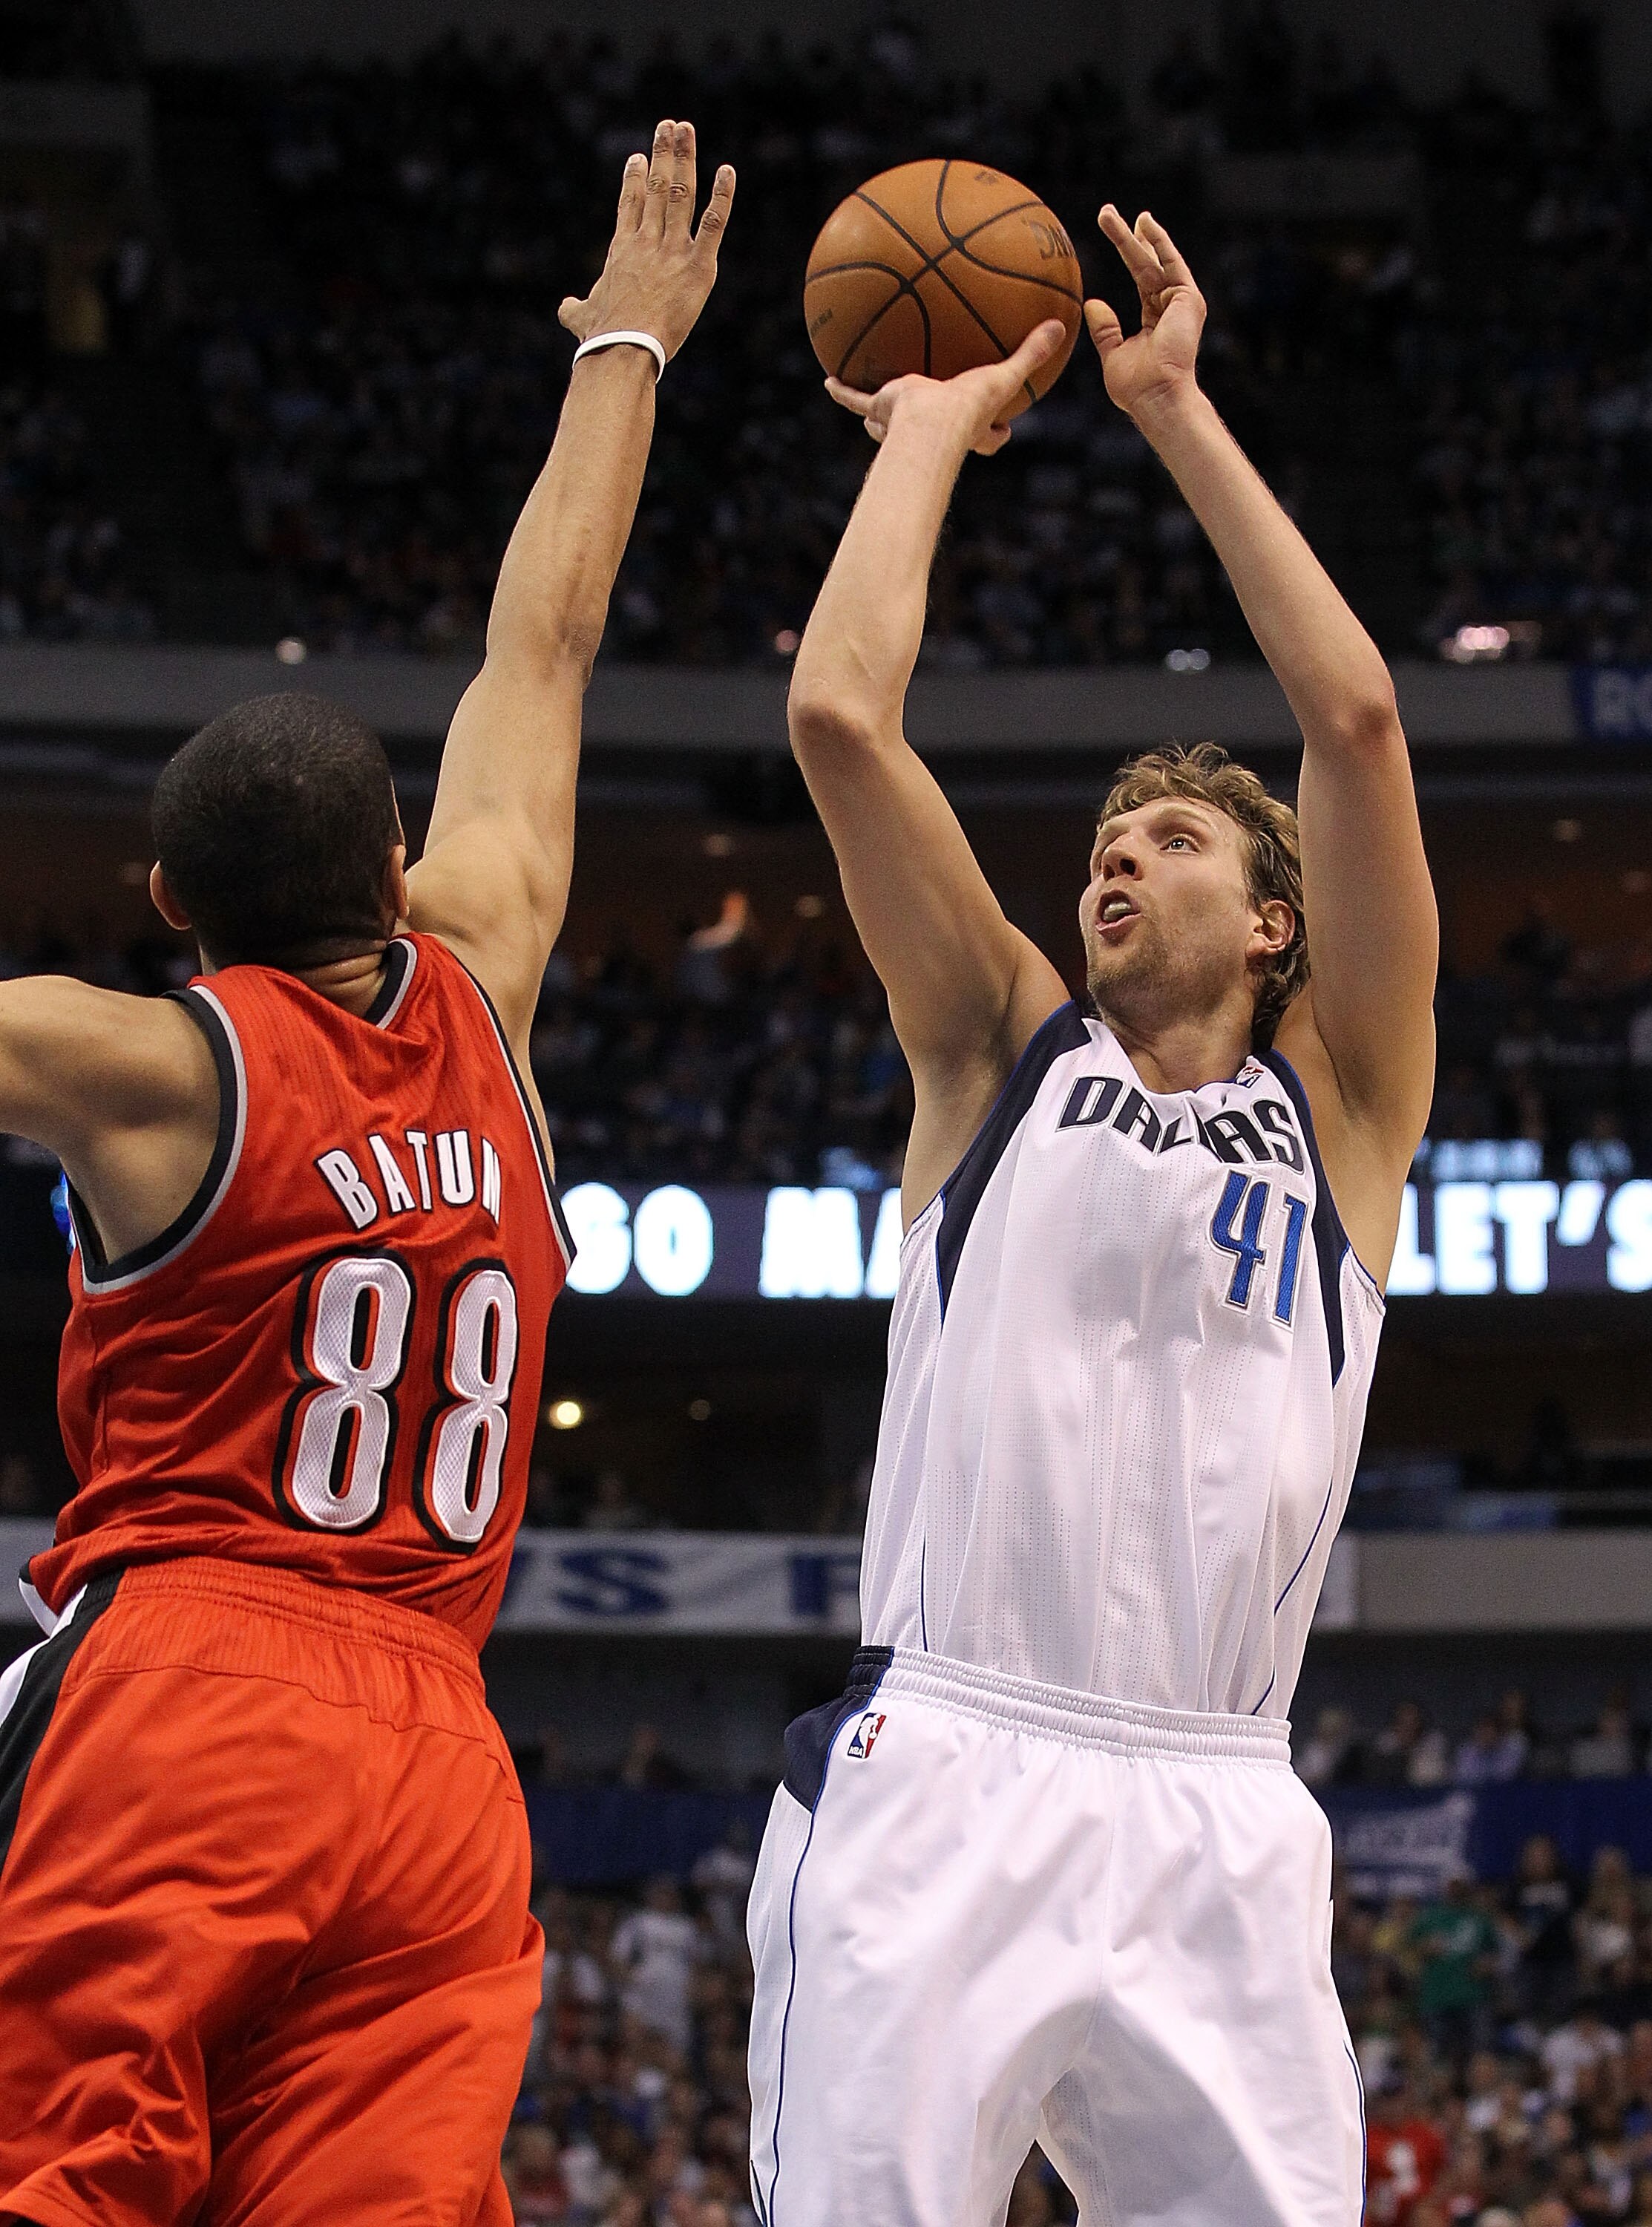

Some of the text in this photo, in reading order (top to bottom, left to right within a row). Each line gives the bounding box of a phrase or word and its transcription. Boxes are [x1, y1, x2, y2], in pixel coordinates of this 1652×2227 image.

[1208, 1168, 1311, 1332] 41
[1386, 1179, 1652, 1295] LET'S
[273, 1249, 519, 1553] 88
[848, 1746, 863, 1757] NBA
